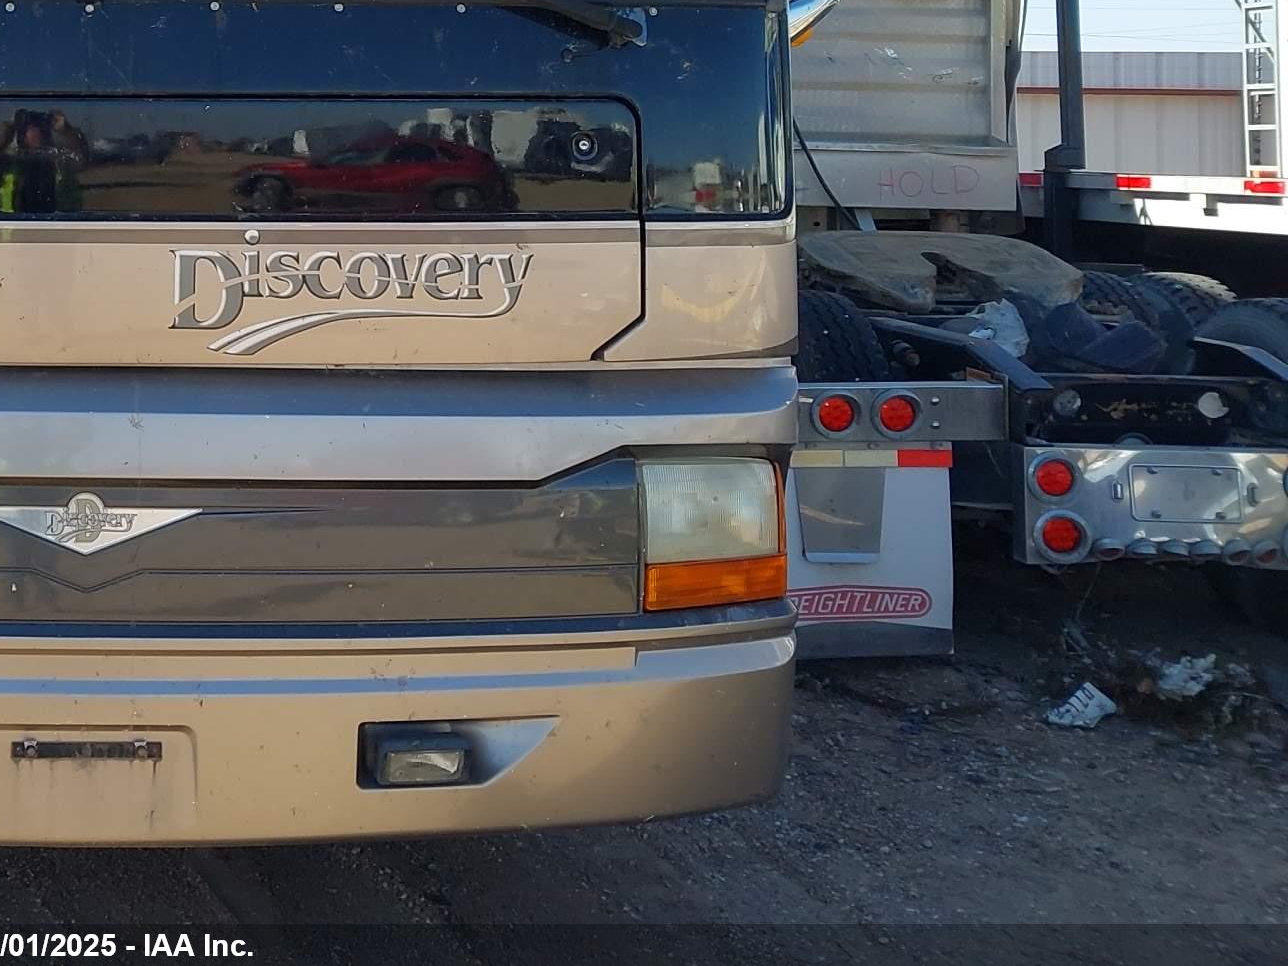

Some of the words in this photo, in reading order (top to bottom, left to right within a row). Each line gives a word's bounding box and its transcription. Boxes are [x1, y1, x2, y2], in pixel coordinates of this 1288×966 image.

[877, 164, 981, 201] HOLD
[168, 229, 535, 331] Discovery
[44, 506, 138, 536] Discovery
[790, 592, 922, 614] EIGHTLINER
